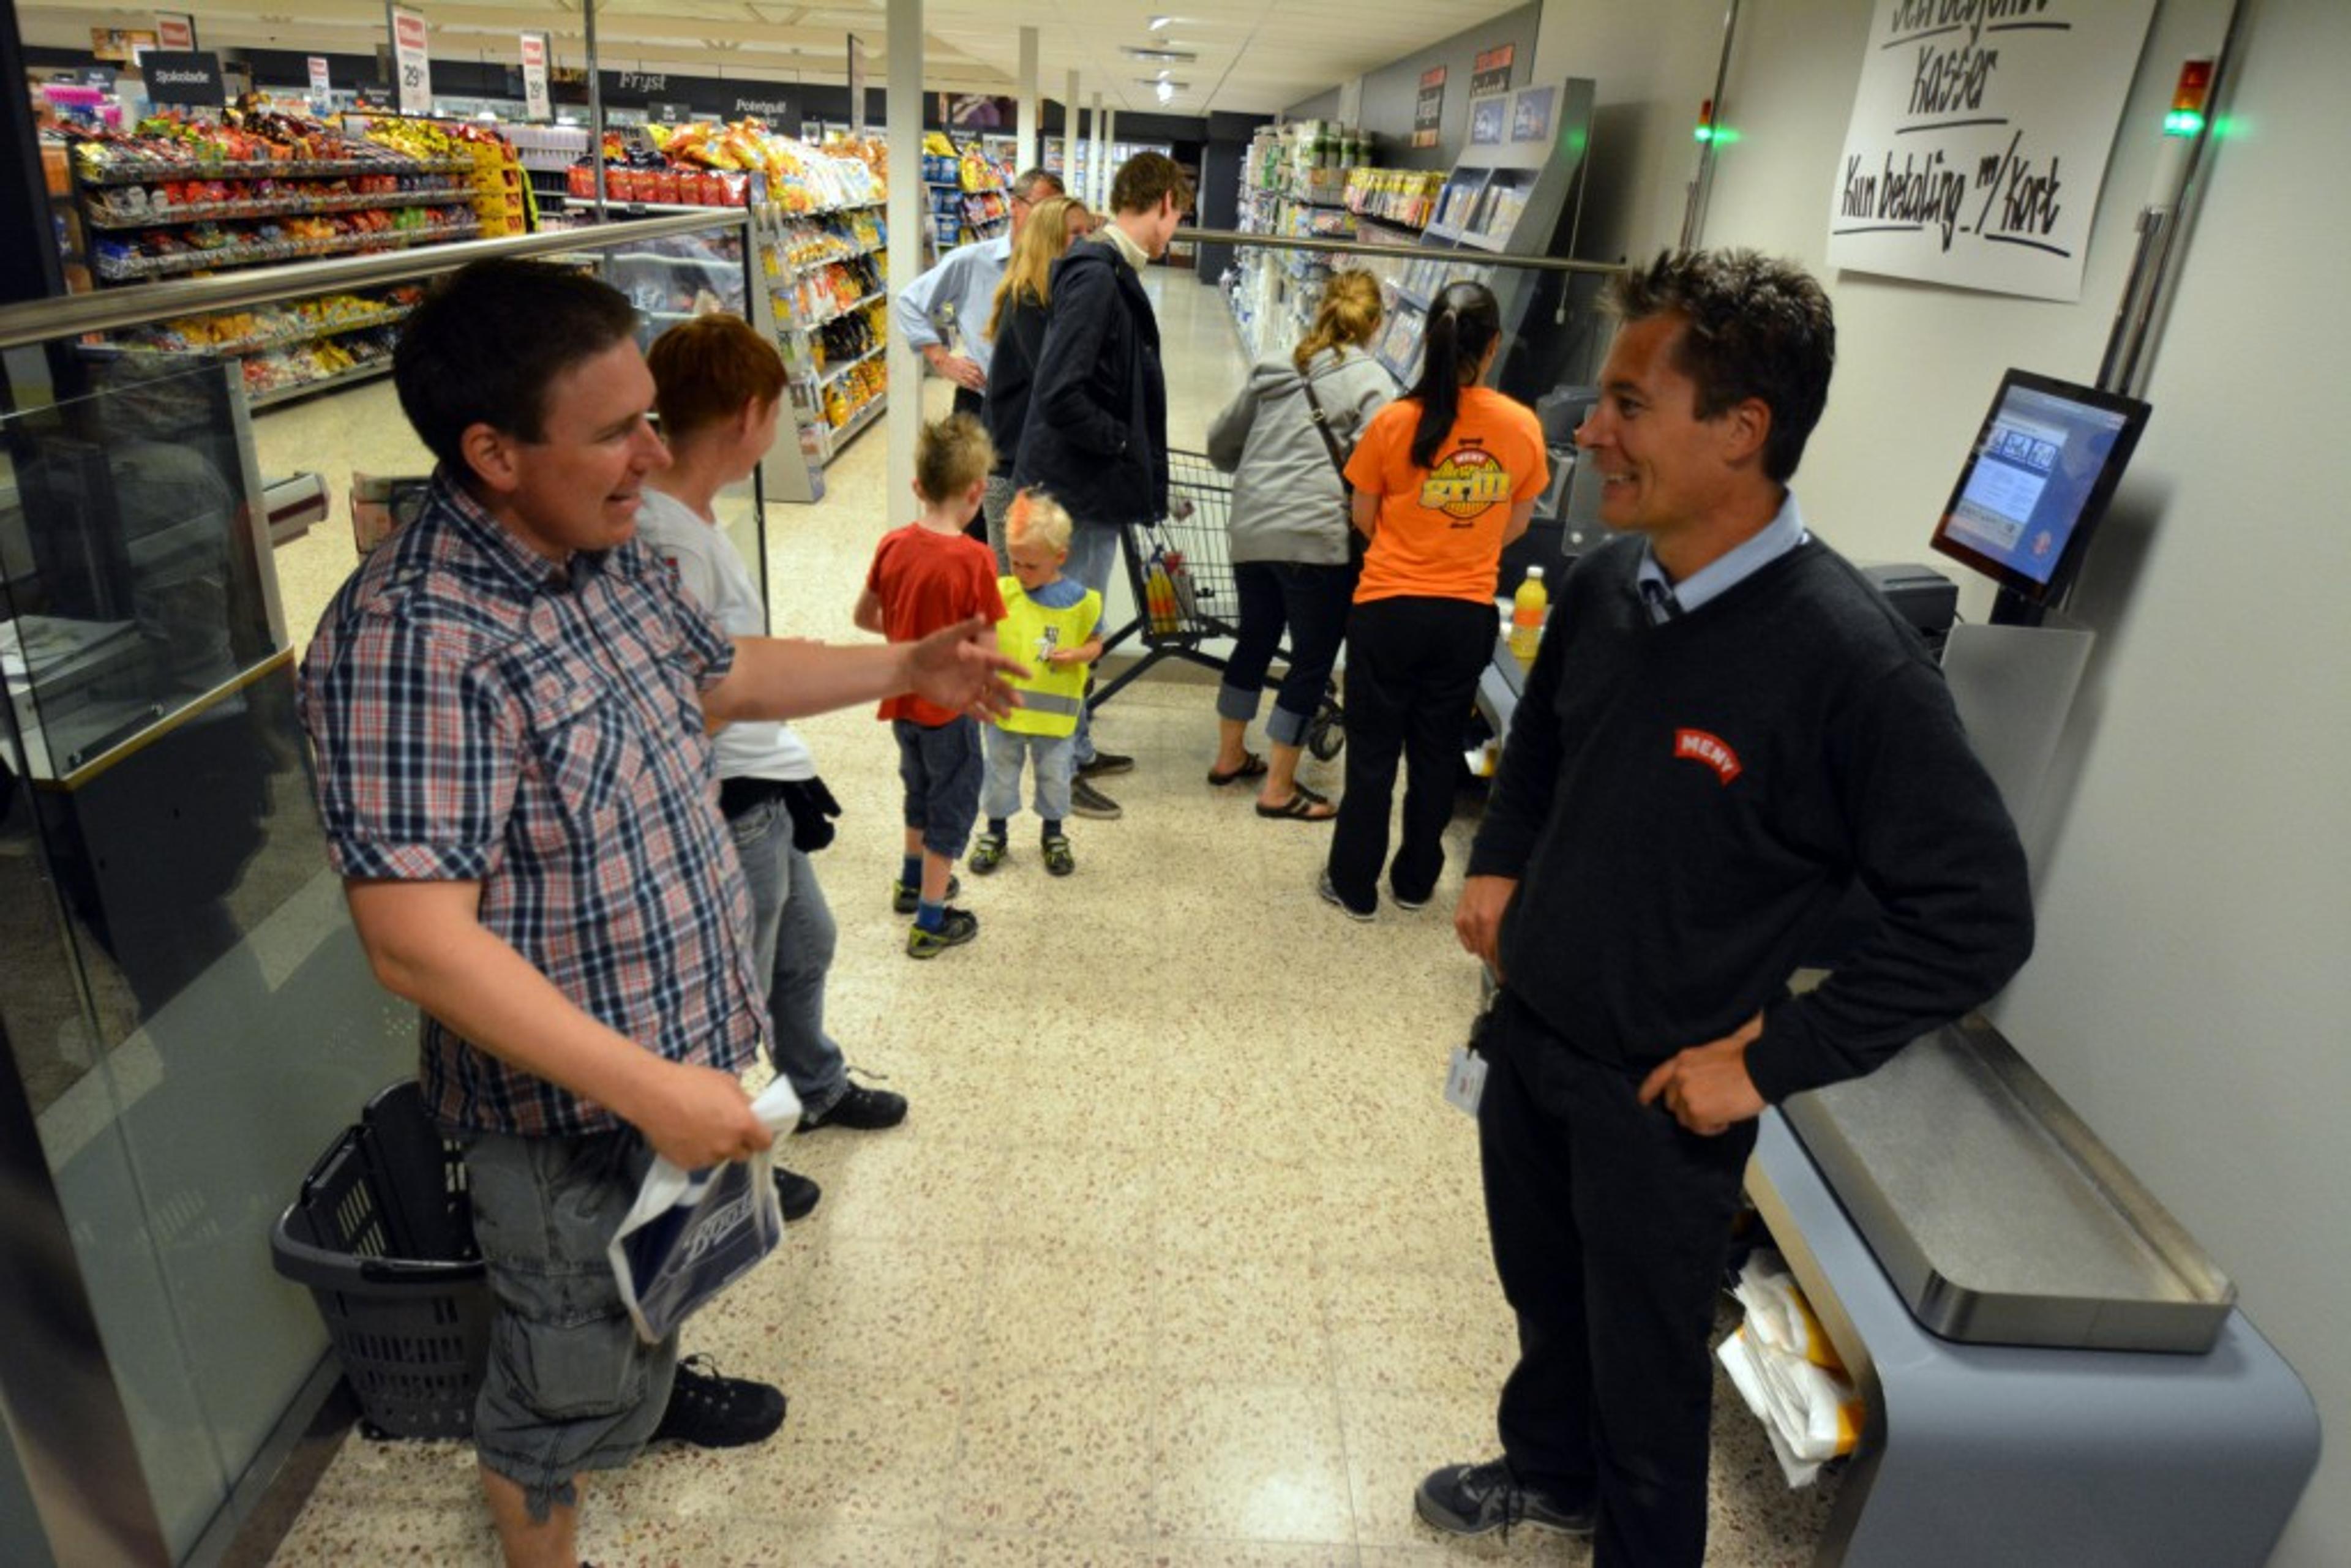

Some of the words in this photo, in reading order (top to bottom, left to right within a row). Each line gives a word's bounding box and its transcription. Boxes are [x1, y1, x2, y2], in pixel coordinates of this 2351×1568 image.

[618, 71, 666, 92] Fryst
[1908, 45, 1998, 114] Kasser
[1842, 154, 1877, 217] Kun
[1878, 149, 1966, 253] betaling
[1419, 469, 1510, 509] grill
[1681, 734, 1734, 773] MENY
